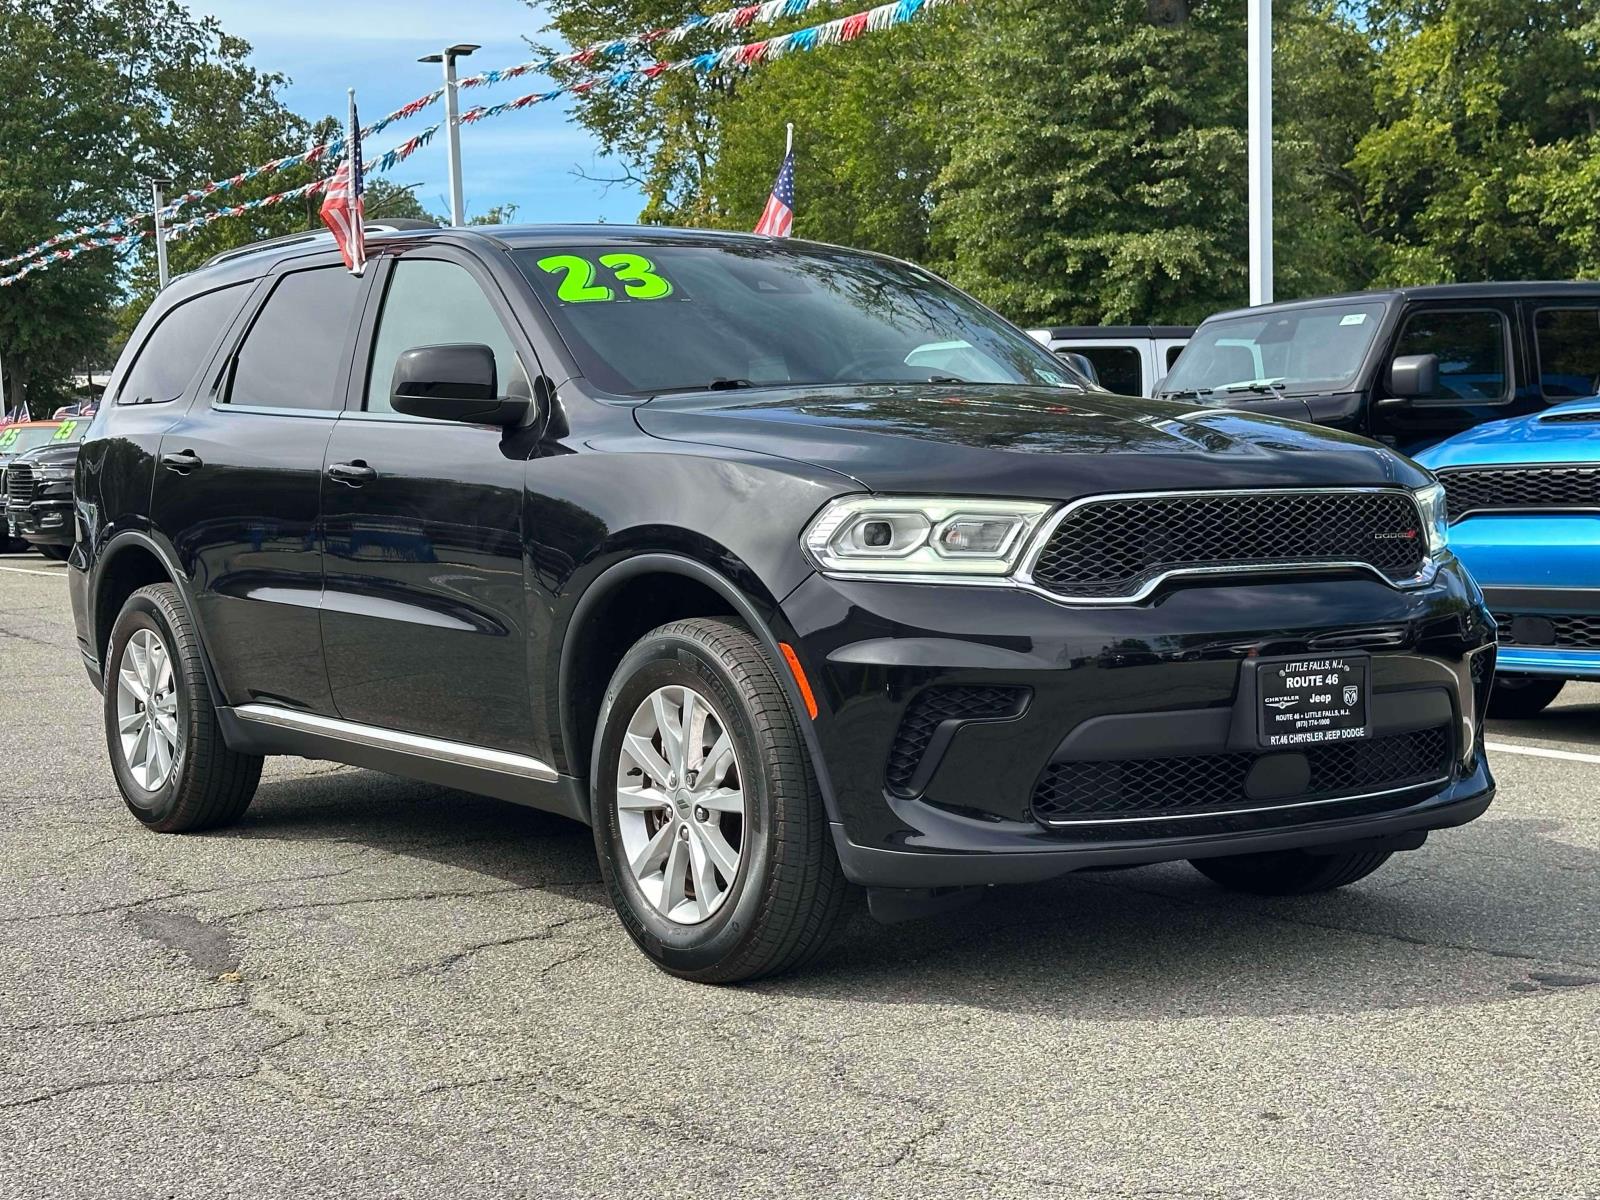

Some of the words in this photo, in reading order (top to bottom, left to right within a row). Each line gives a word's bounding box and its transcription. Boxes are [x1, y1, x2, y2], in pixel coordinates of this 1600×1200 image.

[536, 253, 674, 303] 23
[54, 420, 77, 440] 23
[1285, 662, 1308, 673] LITTLE
[1309, 660, 1332, 671] FALLS,
[1333, 659, 1344, 669] N.J.
[1286, 675, 1323, 689] ROUTE
[1326, 673, 1339, 685] 46
[1264, 695, 1300, 703] CHRYSLER
[1309, 693, 1332, 704] Jeep
[1275, 714, 1293, 722] ROUTE
[1294, 713, 1300, 721] 46
[1304, 711, 1322, 719] LITTLE
[1322, 710, 1340, 718] FALLS,
[1270, 734, 1288, 745] RT.46
[1288, 731, 1324, 745] CHRYSLER
[1324, 730, 1341, 741] JEEP
[1341, 727, 1365, 739] DODGE
